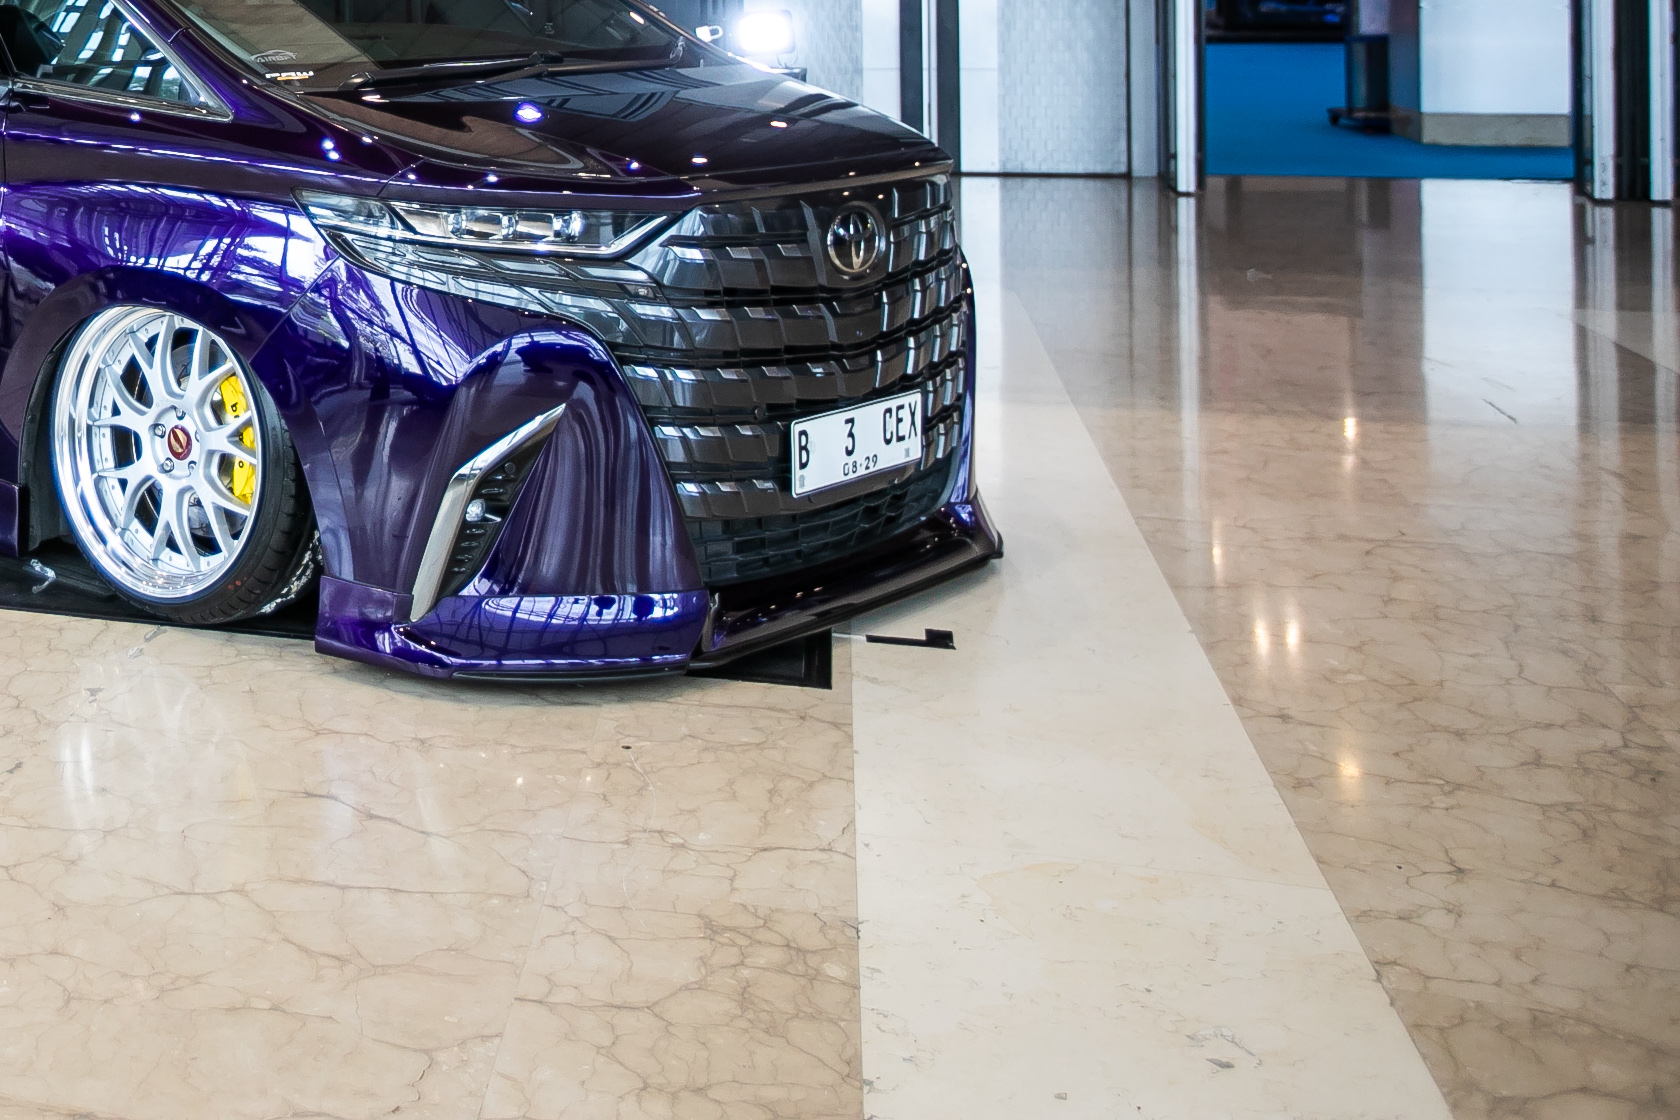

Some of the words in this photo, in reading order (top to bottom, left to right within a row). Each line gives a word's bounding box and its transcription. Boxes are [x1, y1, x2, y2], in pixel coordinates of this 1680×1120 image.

[797, 429, 810, 471] B
[843, 417, 856, 457] 3
[882, 400, 918, 446] CEX
